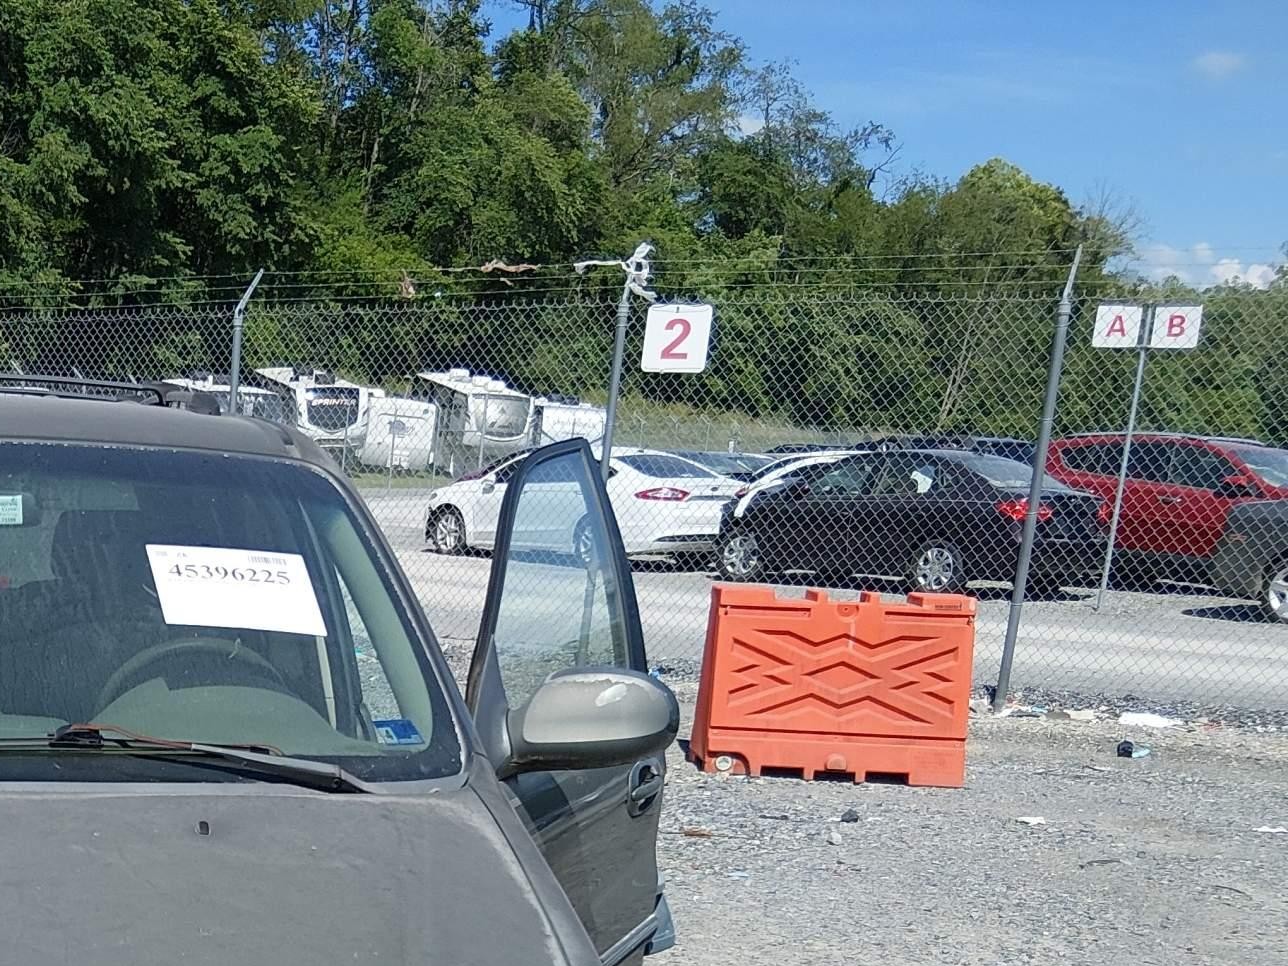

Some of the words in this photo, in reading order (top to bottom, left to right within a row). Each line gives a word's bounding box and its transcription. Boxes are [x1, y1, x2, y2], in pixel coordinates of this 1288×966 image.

[1106, 314, 1127, 338] A
[1166, 314, 1187, 338] B
[660, 318, 692, 360] 2
[168, 563, 291, 585] 45396225
